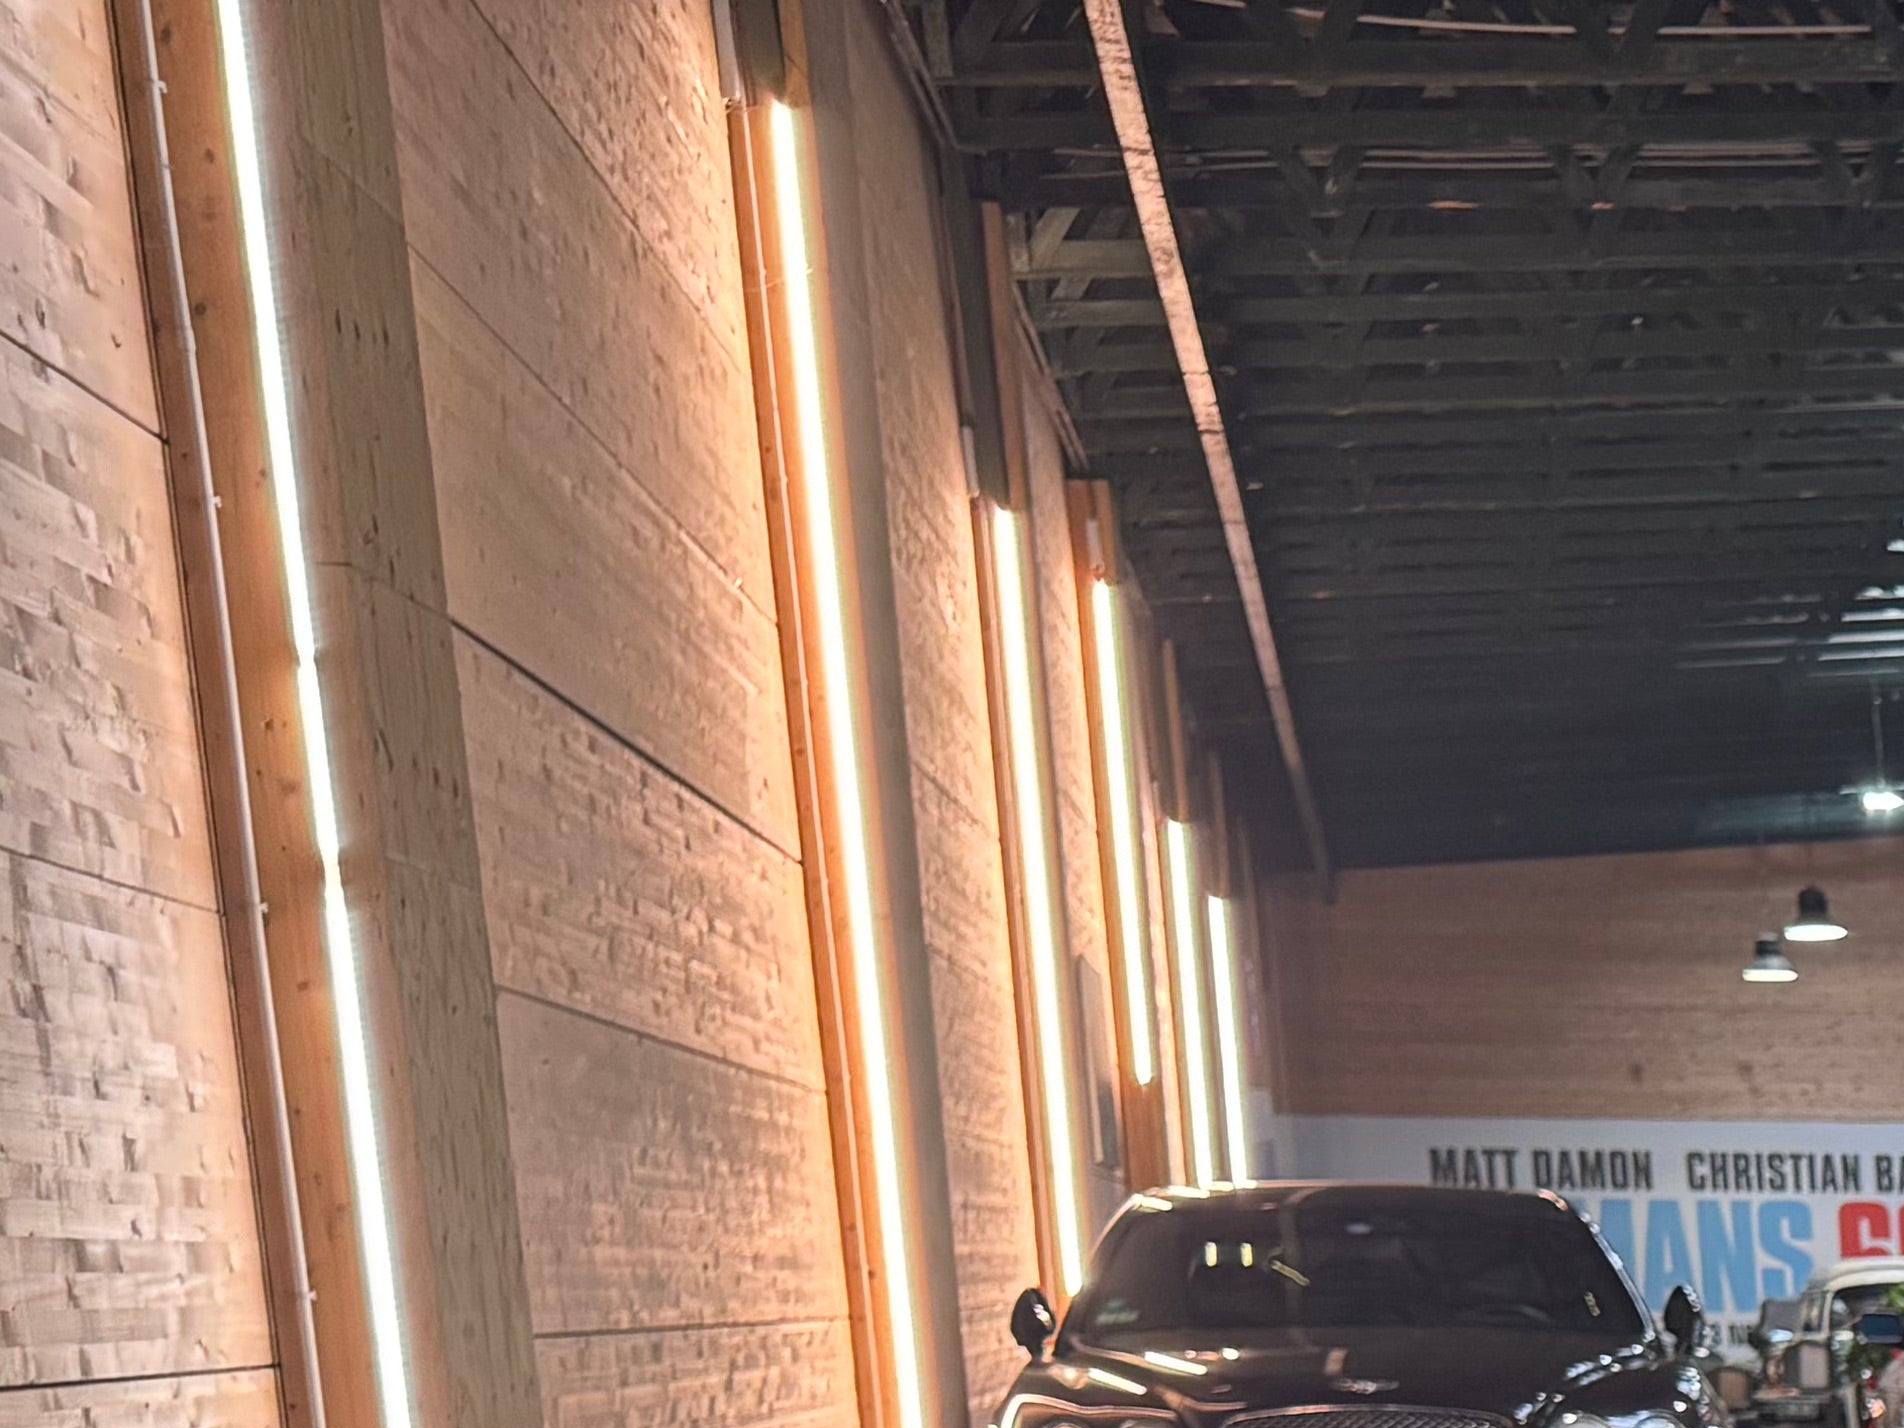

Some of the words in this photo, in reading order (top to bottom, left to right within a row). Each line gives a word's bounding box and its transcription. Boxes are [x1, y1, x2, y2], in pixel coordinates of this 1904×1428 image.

[1429, 1148, 1518, 1188] MATT
[1532, 1150, 1655, 1190] DAMON
[1686, 1151, 1861, 1192] CHRISTIAN
